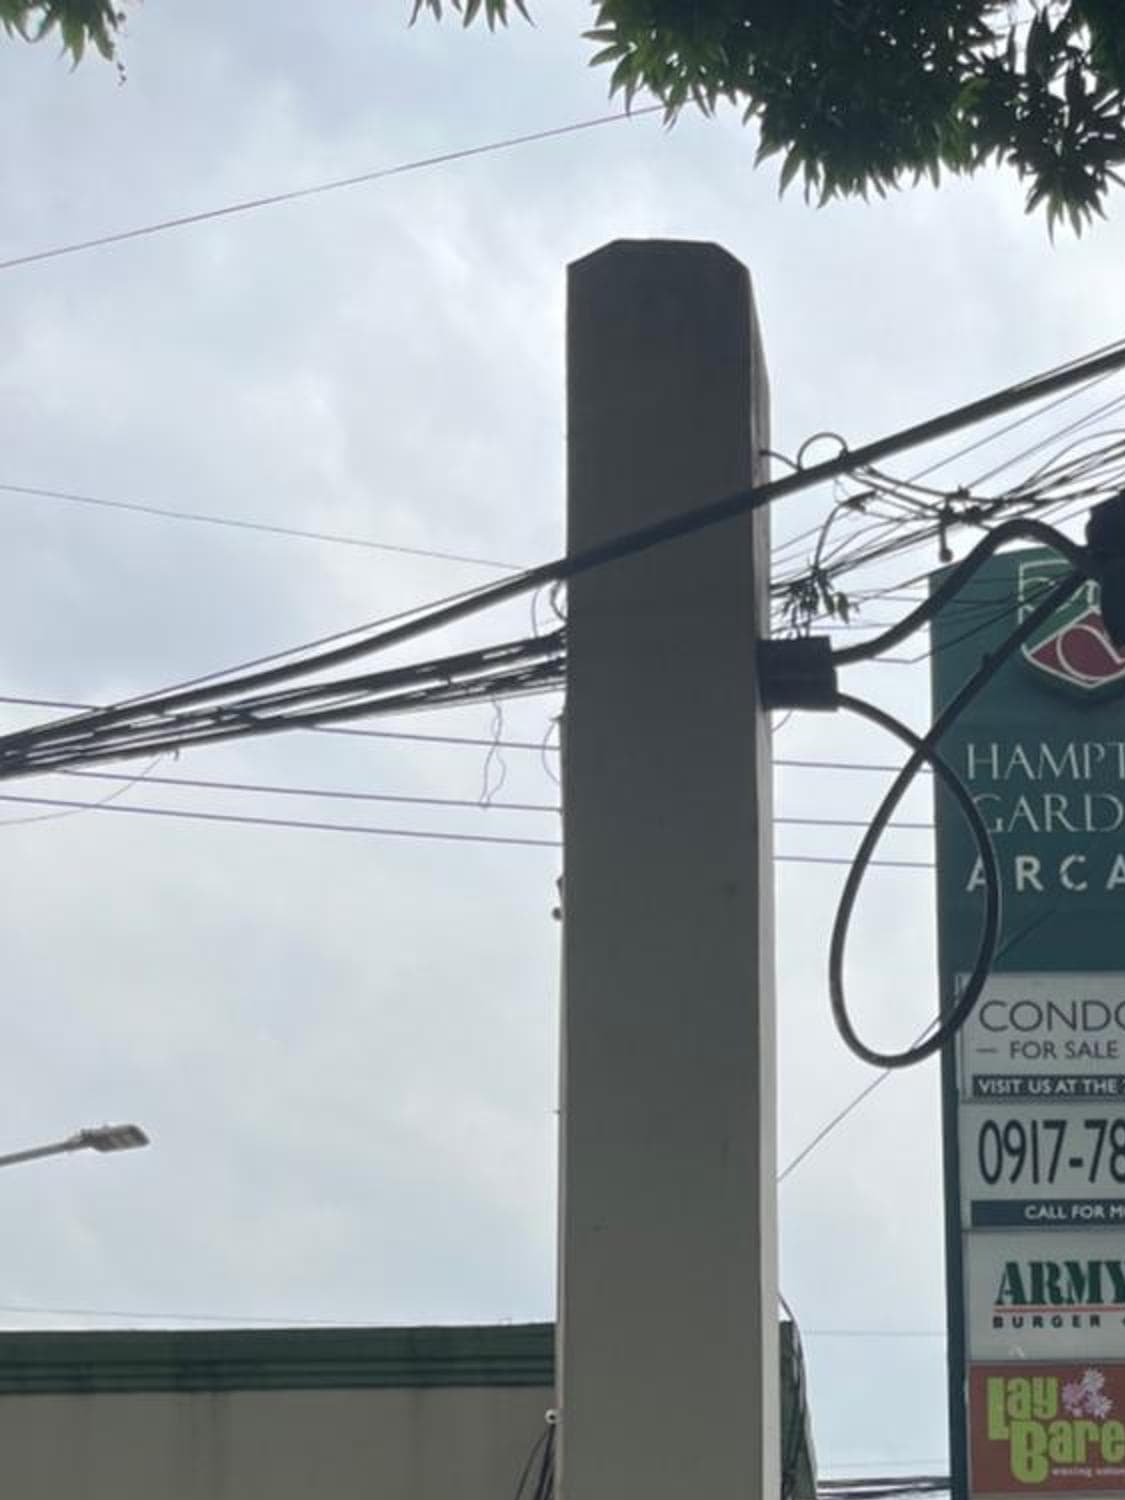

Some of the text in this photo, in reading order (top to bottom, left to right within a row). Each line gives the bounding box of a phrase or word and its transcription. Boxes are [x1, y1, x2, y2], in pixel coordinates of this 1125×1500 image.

[1009, 1040, 1120, 1060] FOR SALE
[977, 1079, 1022, 1094] VISIT
[1028, 1079, 1051, 1094] US
[1053, 1079, 1076, 1094] AT
[1079, 1079, 1116, 1094] THE
[1024, 1204, 1067, 1220] CALL
[1071, 1204, 1105, 1219] FOR
[993, 1314, 1101, 1329] BURGER
[987, 1375, 1058, 1440] Lay
